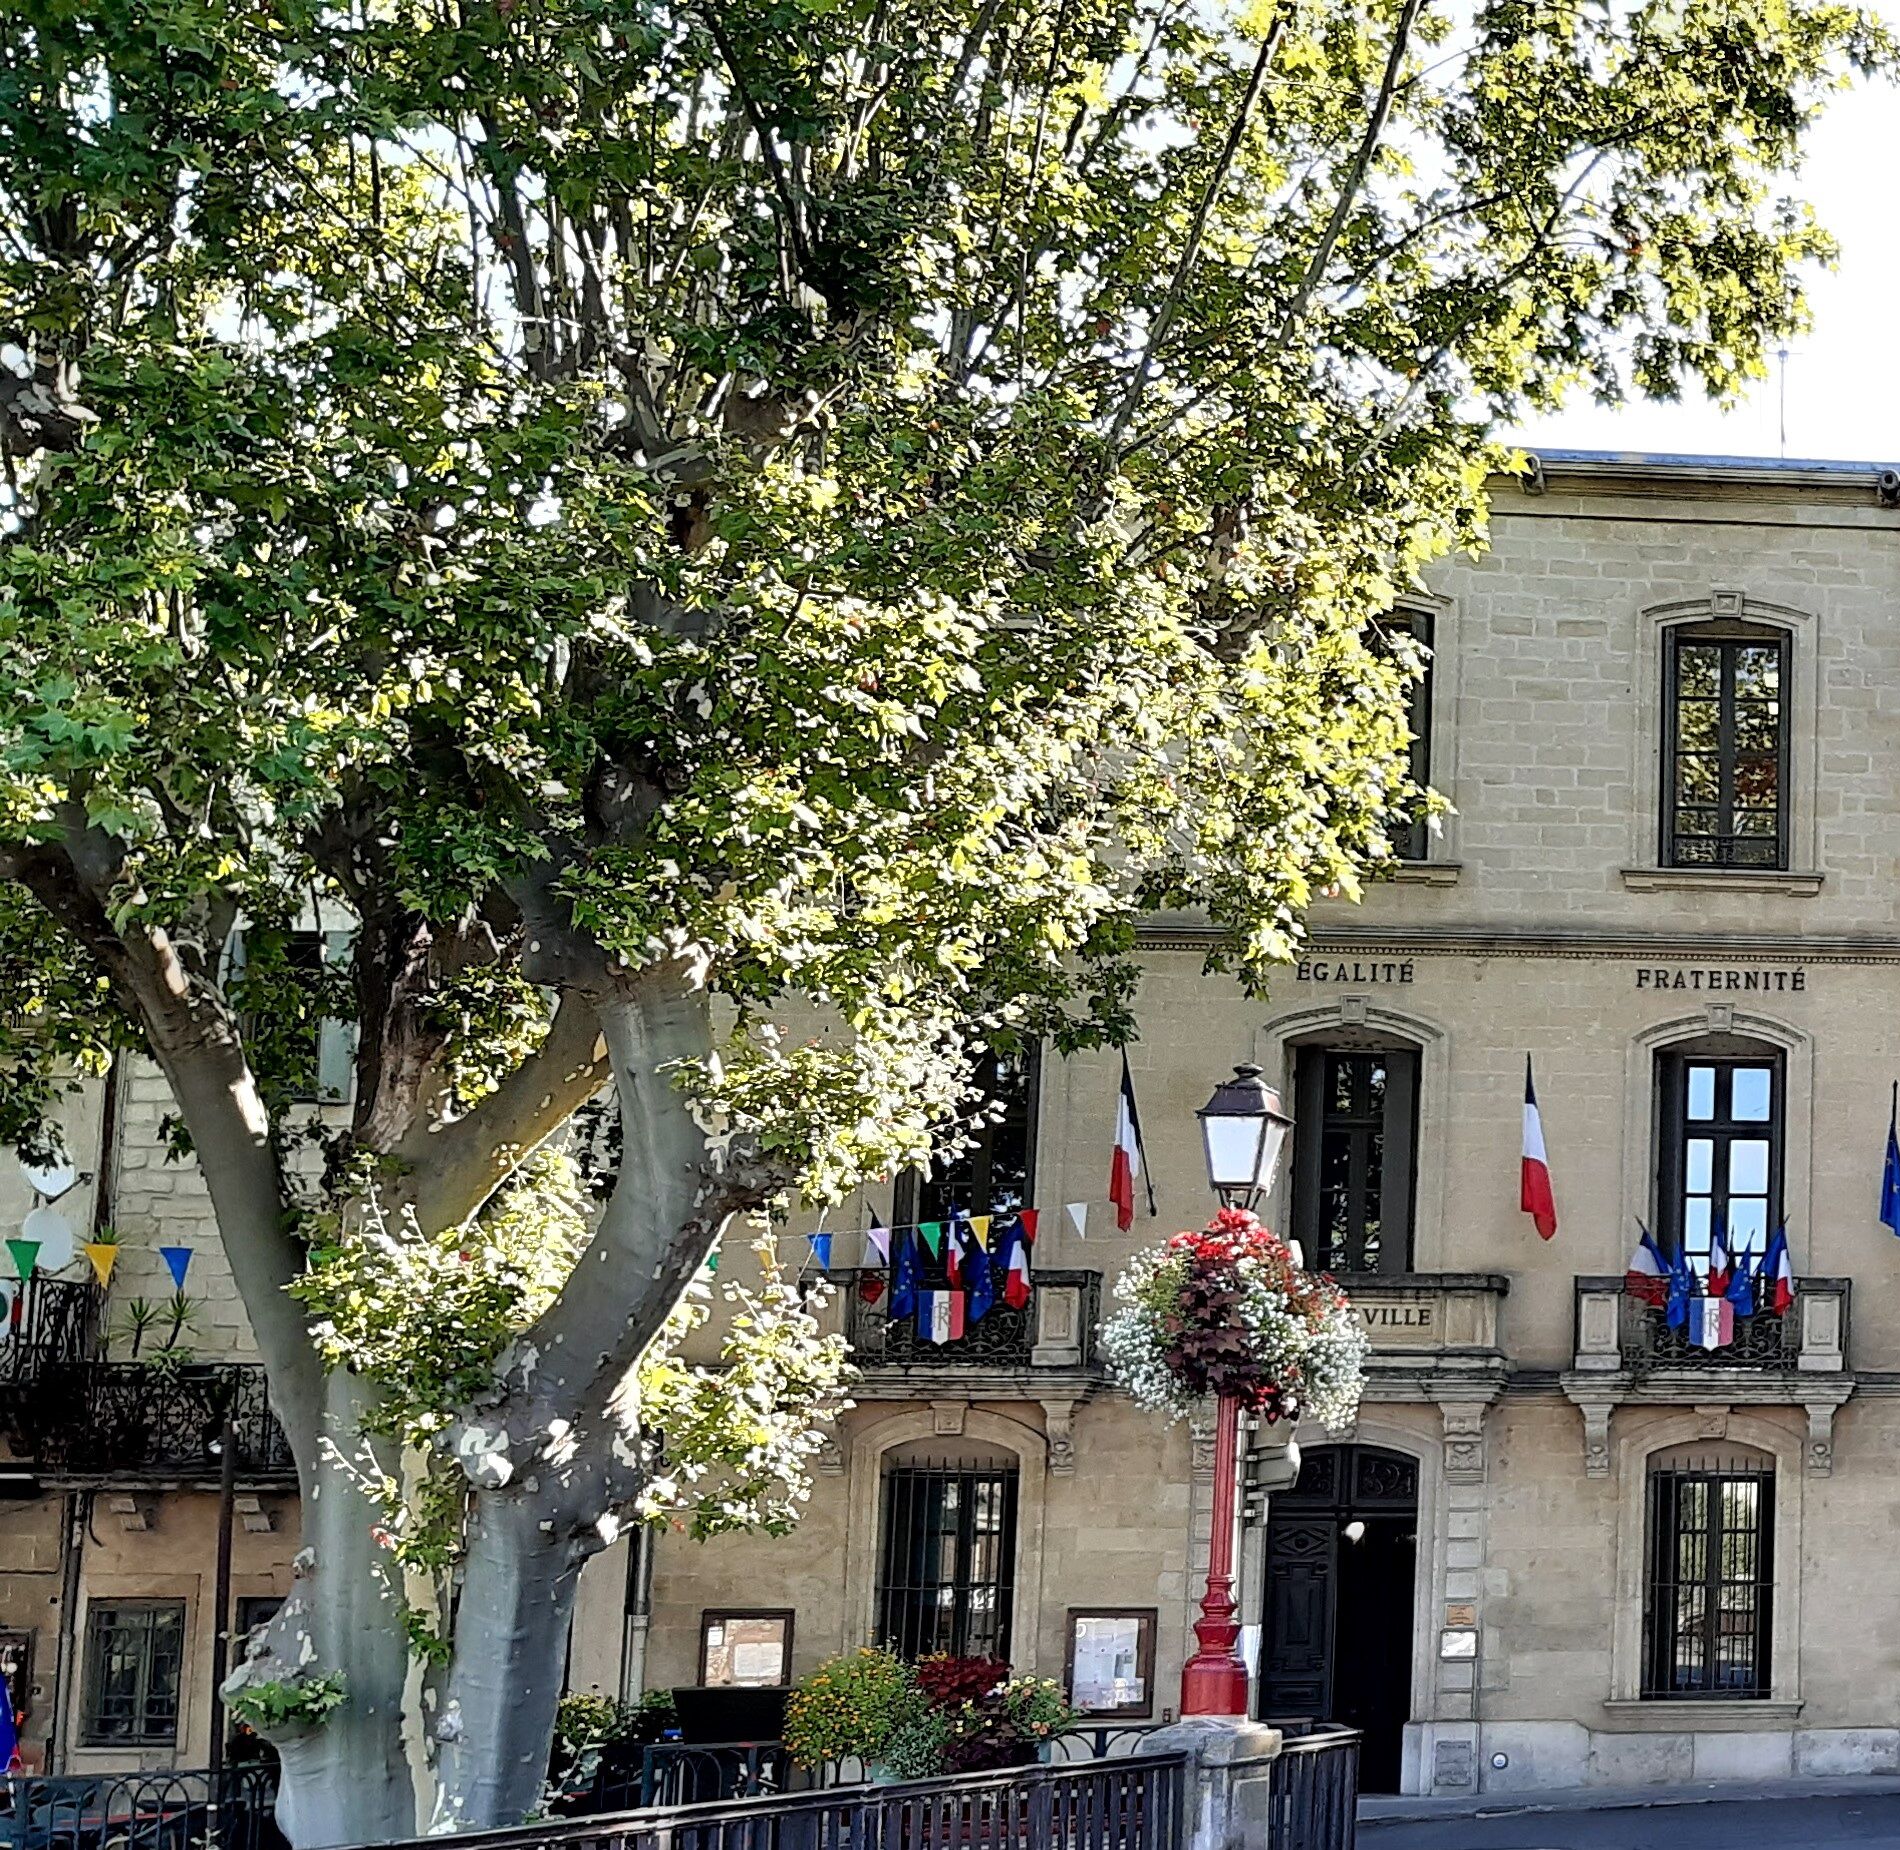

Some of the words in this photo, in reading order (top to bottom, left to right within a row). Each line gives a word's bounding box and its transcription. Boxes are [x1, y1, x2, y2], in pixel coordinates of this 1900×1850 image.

[1296, 955, 1414, 983] ÉGALITÉ
[1636, 966, 1805, 991] FRATERNITÉ
[1362, 1307, 1431, 1326] VILLE
